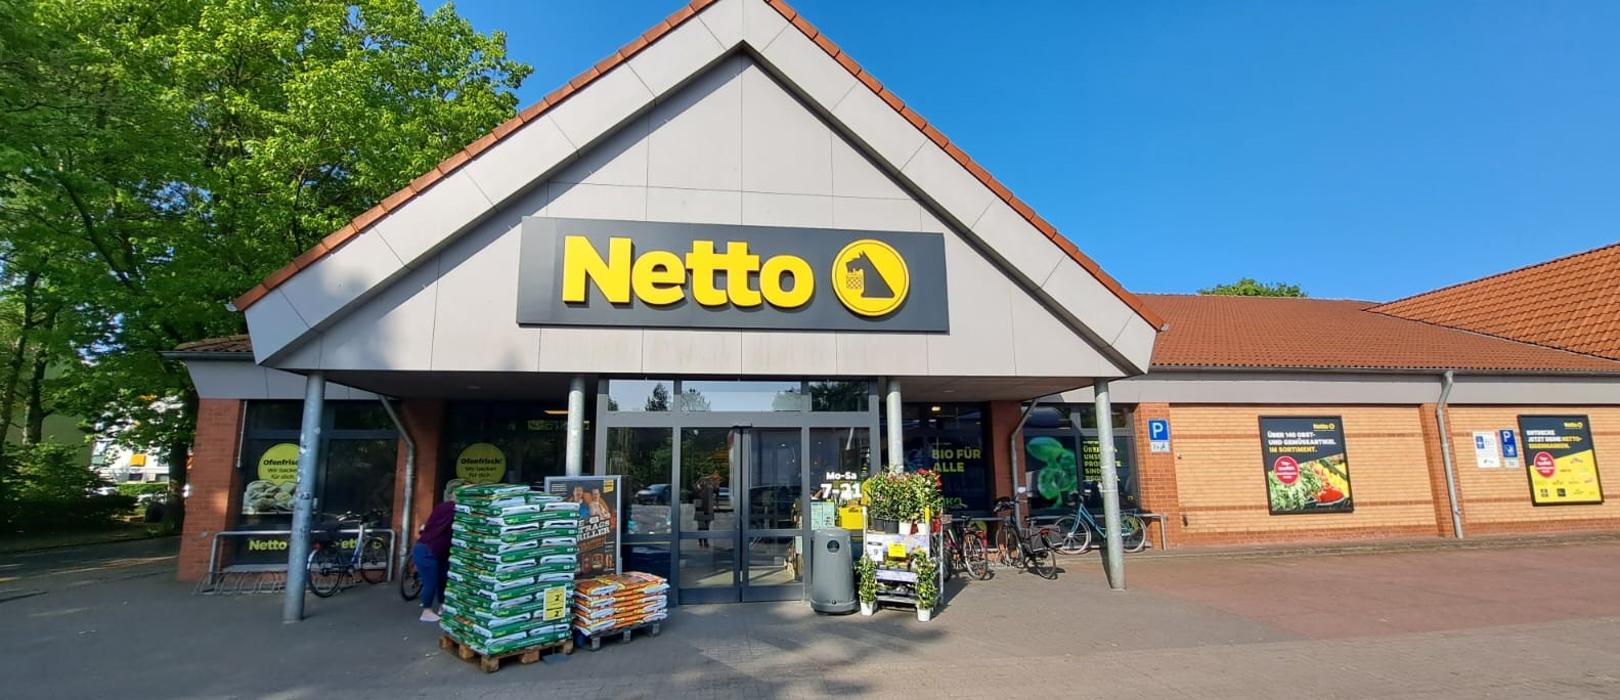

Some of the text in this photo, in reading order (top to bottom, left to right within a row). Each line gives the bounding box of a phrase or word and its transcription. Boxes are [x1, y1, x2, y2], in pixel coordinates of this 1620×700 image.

[563, 235, 815, 308] Netto
[1152, 422, 1164, 439] P
[1502, 430, 1512, 443] P
[932, 446, 981, 460] BIO FÜR
[933, 462, 965, 473] ALLE
[826, 471, 858, 480] Mo-Sa
[820, 482, 863, 500] 7-21
[248, 539, 288, 551] Netto
